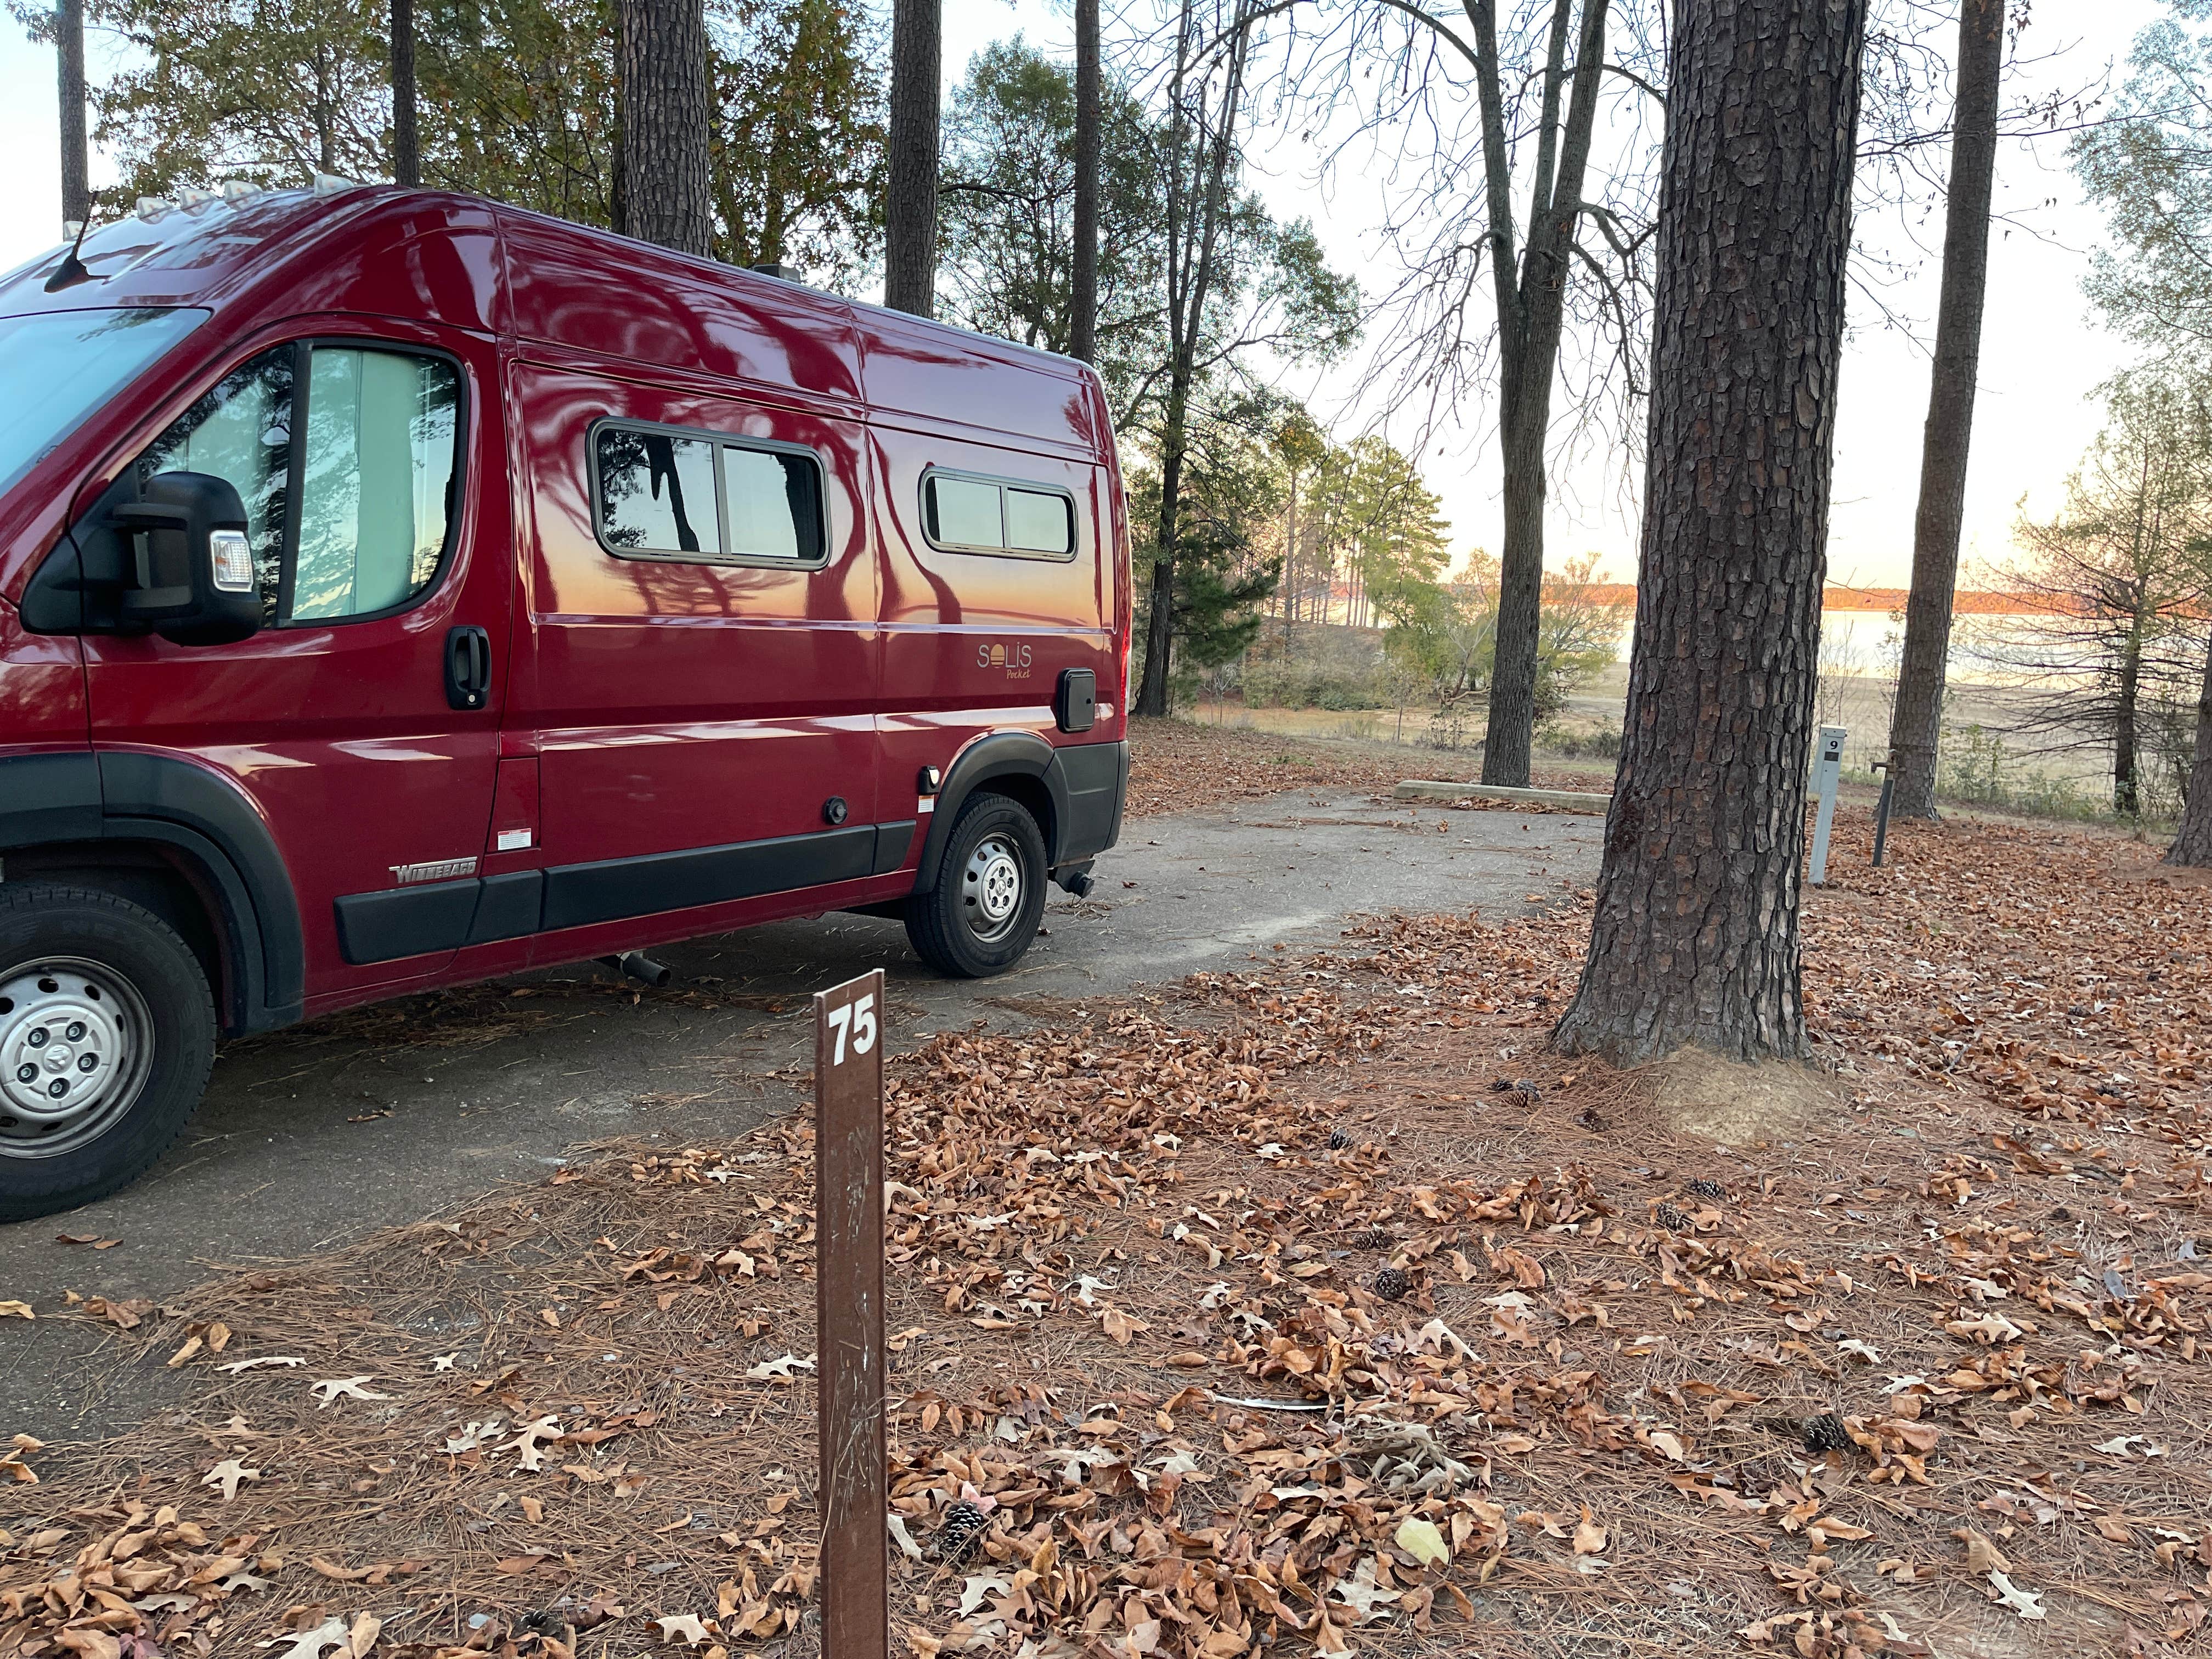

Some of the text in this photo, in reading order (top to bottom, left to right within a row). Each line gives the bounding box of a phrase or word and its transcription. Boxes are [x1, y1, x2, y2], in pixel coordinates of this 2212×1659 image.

[1006, 669, 1031, 679] Pocket
[1830, 741, 1838, 749] 9
[388, 856, 478, 884] WINNEBAGO
[828, 993, 877, 1066] 75
